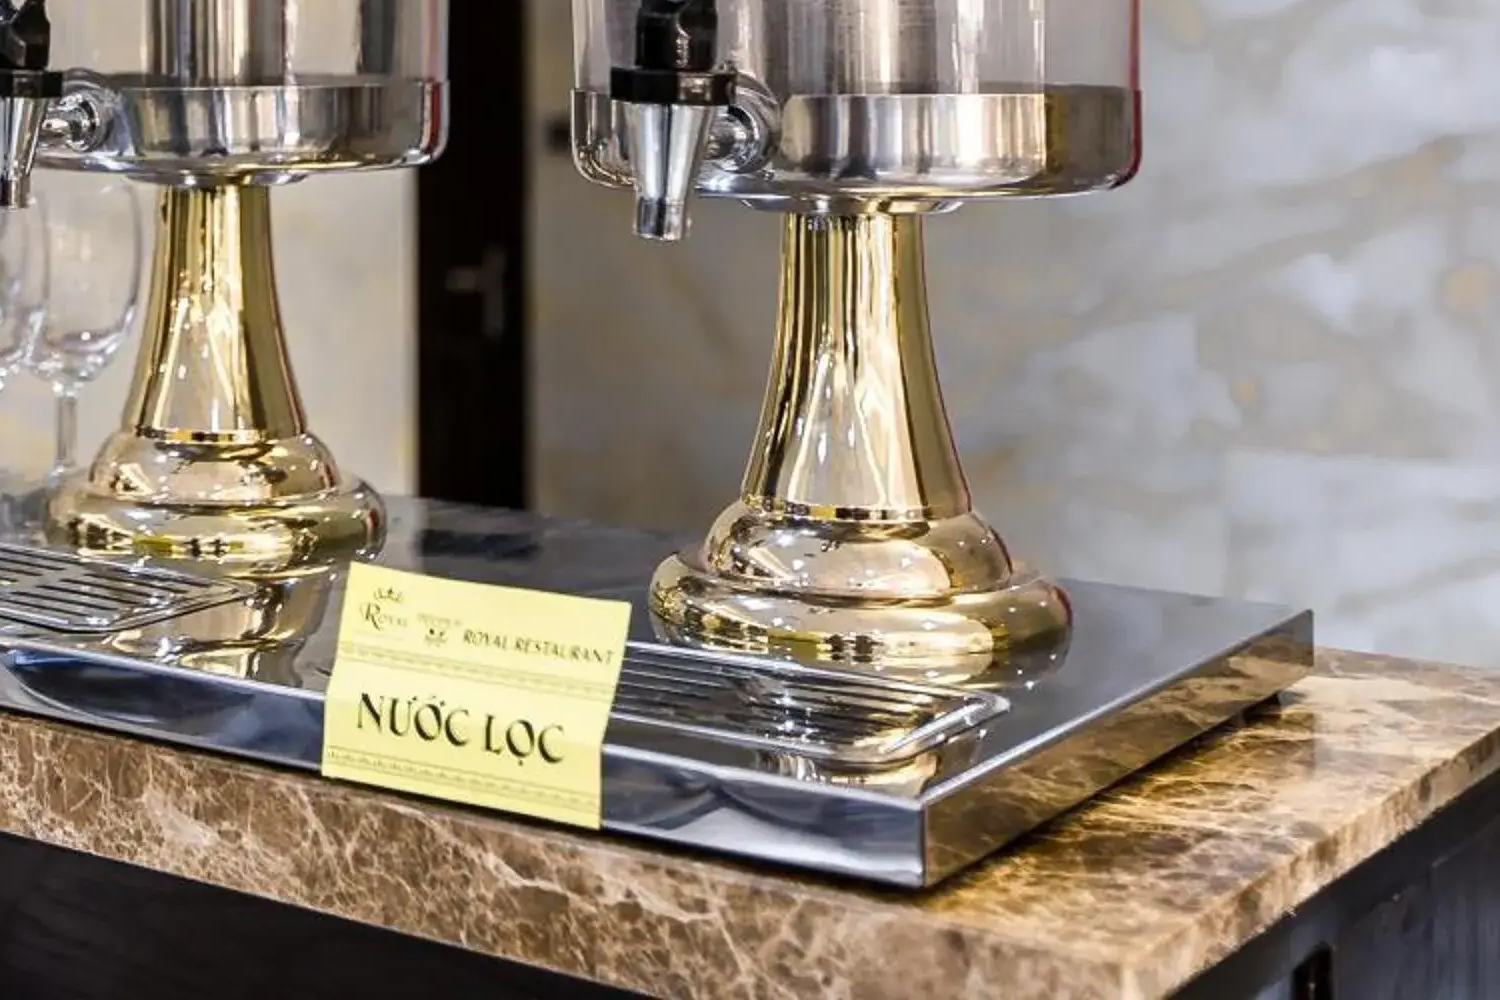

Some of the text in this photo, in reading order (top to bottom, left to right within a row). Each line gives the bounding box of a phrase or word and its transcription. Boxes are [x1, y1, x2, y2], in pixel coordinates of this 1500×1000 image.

[463, 629, 615, 665] ROYAL RESTAURANT
[357, 693, 565, 766] NƯỚC LỌC
